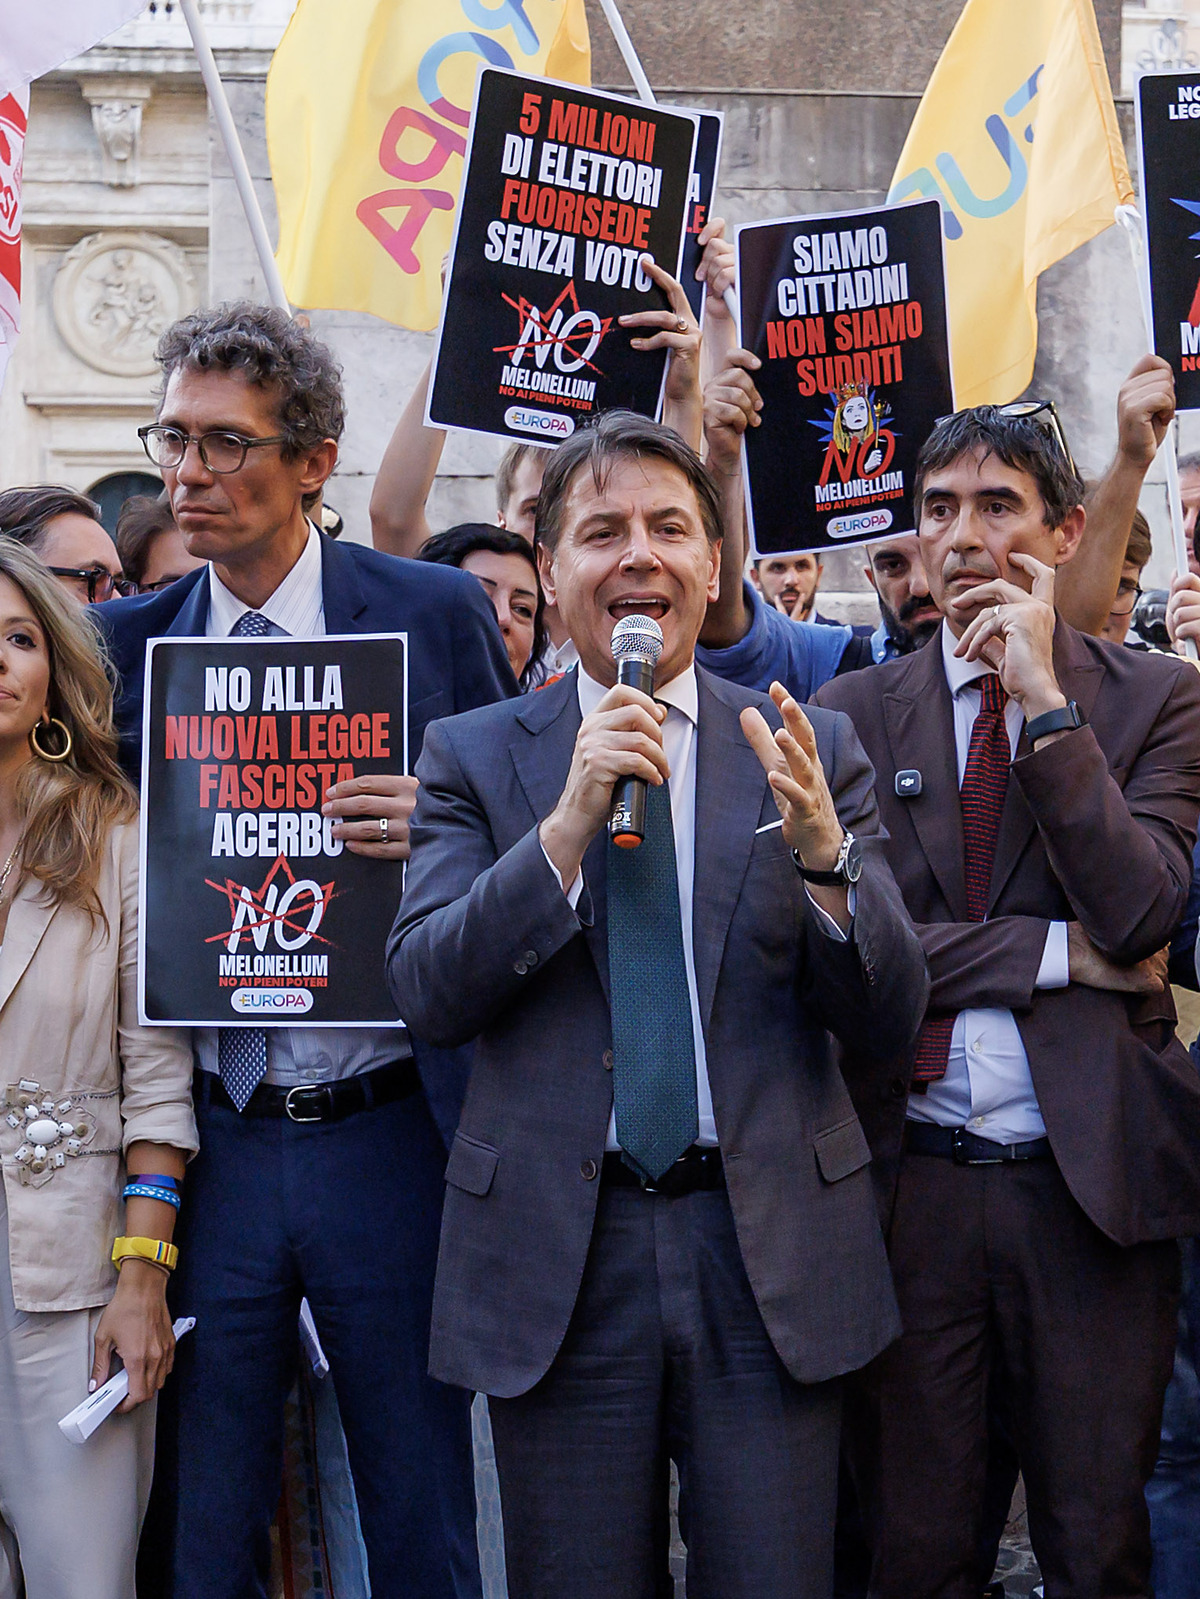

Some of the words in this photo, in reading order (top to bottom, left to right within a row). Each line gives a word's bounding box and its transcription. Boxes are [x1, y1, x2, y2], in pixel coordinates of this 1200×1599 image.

[518, 92, 543, 135] 5
[548, 99, 657, 163] MILIONI
[500, 133, 534, 179] DI
[538, 141, 663, 208] ELETTORI
[500, 178, 653, 249] FUORISEDE
[484, 220, 576, 278] SENZA
[585, 241, 656, 293] VOTO
[793, 226, 887, 274] SIAMO
[777, 262, 909, 317] CITTADINI
[511, 306, 602, 373] NO
[766, 317, 827, 360] NON
[834, 300, 923, 351] SIAMO
[500, 365, 597, 402] MELONELLUM
[796, 345, 903, 397] SUDDITI
[498, 385, 516, 396] NO
[516, 388, 529, 399] AI
[528, 391, 556, 405] PIENI
[556, 396, 593, 411] POTERI
[818, 428, 895, 488] NO
[814, 470, 904, 503] MELONELLUM
[815, 502, 832, 512] NO
[833, 500, 844, 510] AI
[845, 496, 870, 508] PIENI
[871, 489, 904, 503] POTERI
[204, 666, 252, 712] NO
[261, 665, 344, 711] ALLA
[165, 714, 280, 760] NUOVA
[290, 713, 391, 759] LEGGE
[211, 812, 344, 858] ACERBO
[226, 879, 325, 955] NO
[218, 977, 238, 987] NO
[239, 977, 252, 987] AI
[253, 977, 284, 987] PIENI
[286, 977, 328, 988] POTERI
[219, 954, 329, 977] MELONELLUM
